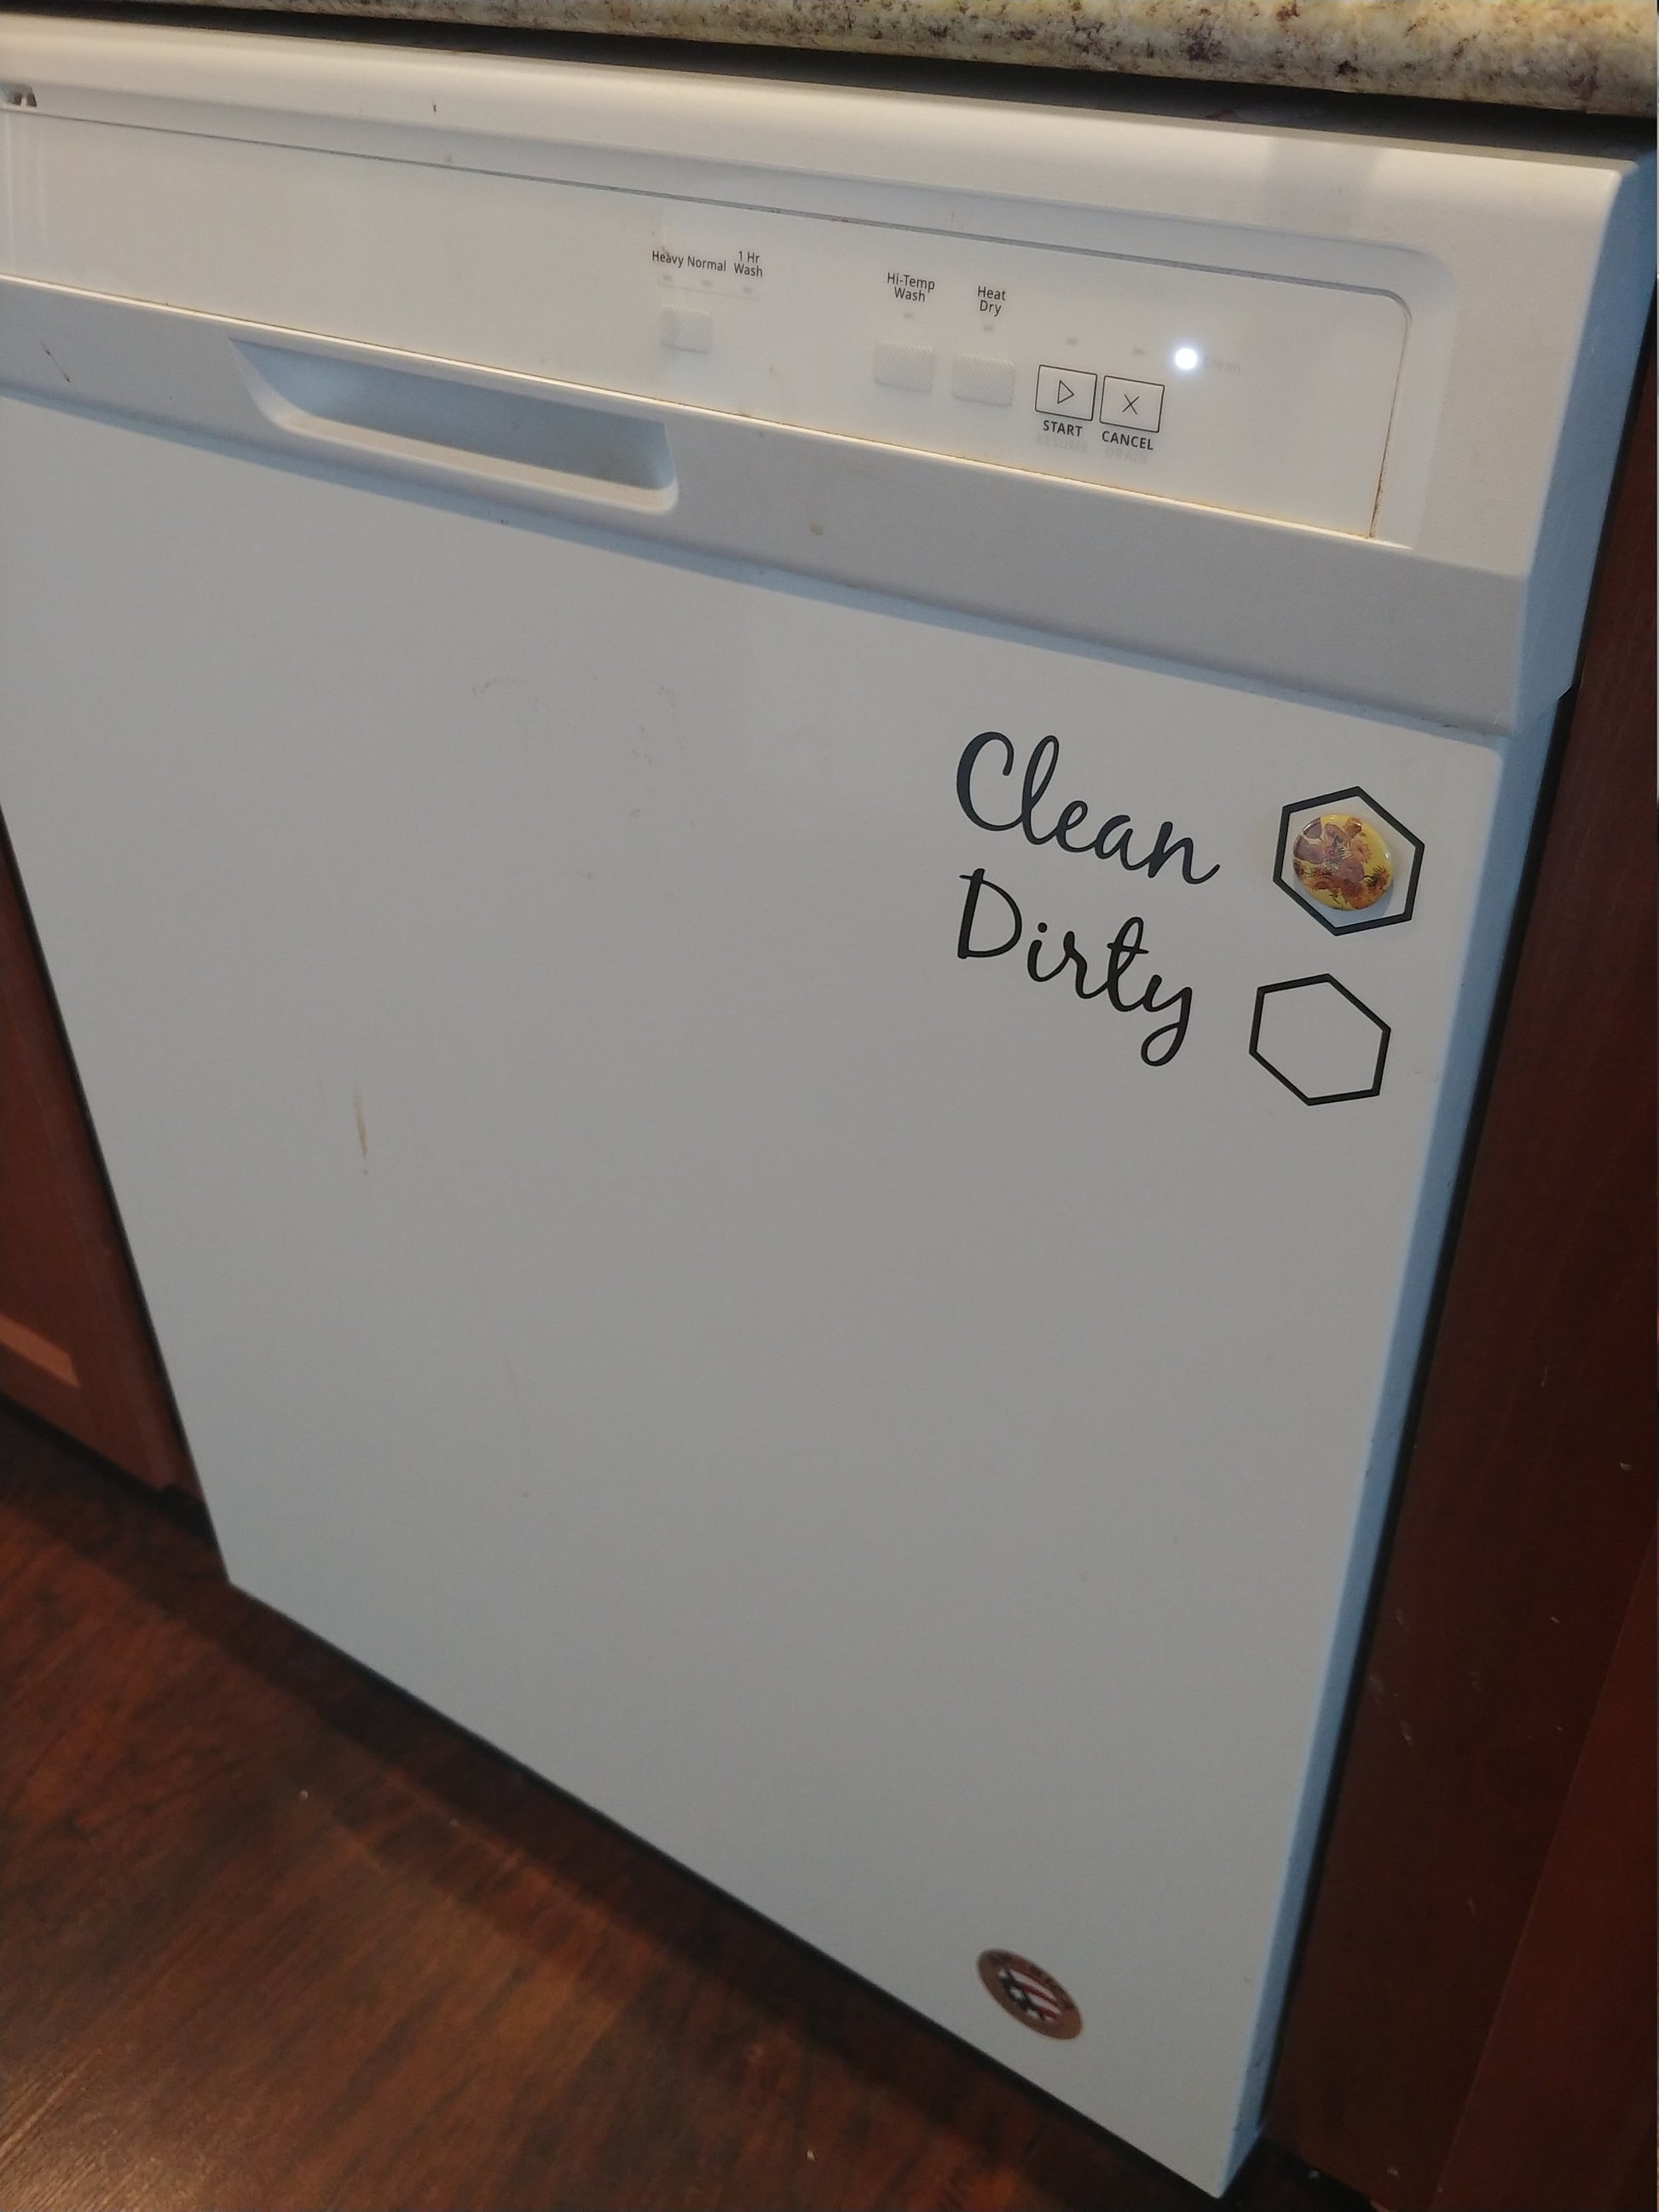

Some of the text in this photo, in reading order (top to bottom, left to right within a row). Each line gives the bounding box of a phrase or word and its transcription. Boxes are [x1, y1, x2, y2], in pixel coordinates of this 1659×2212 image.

[651, 250, 726, 273] Heavy Normal
[737, 250, 760, 264] 1 Hr
[733, 261, 763, 278] Wash
[887, 272, 935, 291] Hi-Temp
[893, 286, 926, 303] Wash
[977, 286, 1006, 302] Heat
[980, 300, 1003, 318] Dry
[1043, 419, 1083, 437] START
[1036, 432, 1091, 453] RESUME
[1101, 430, 1153, 451] CANCEL
[1105, 447, 1148, 465] DRAIN
[956, 731, 1220, 885] Clean
[957, 868, 1193, 1067] Dirty
